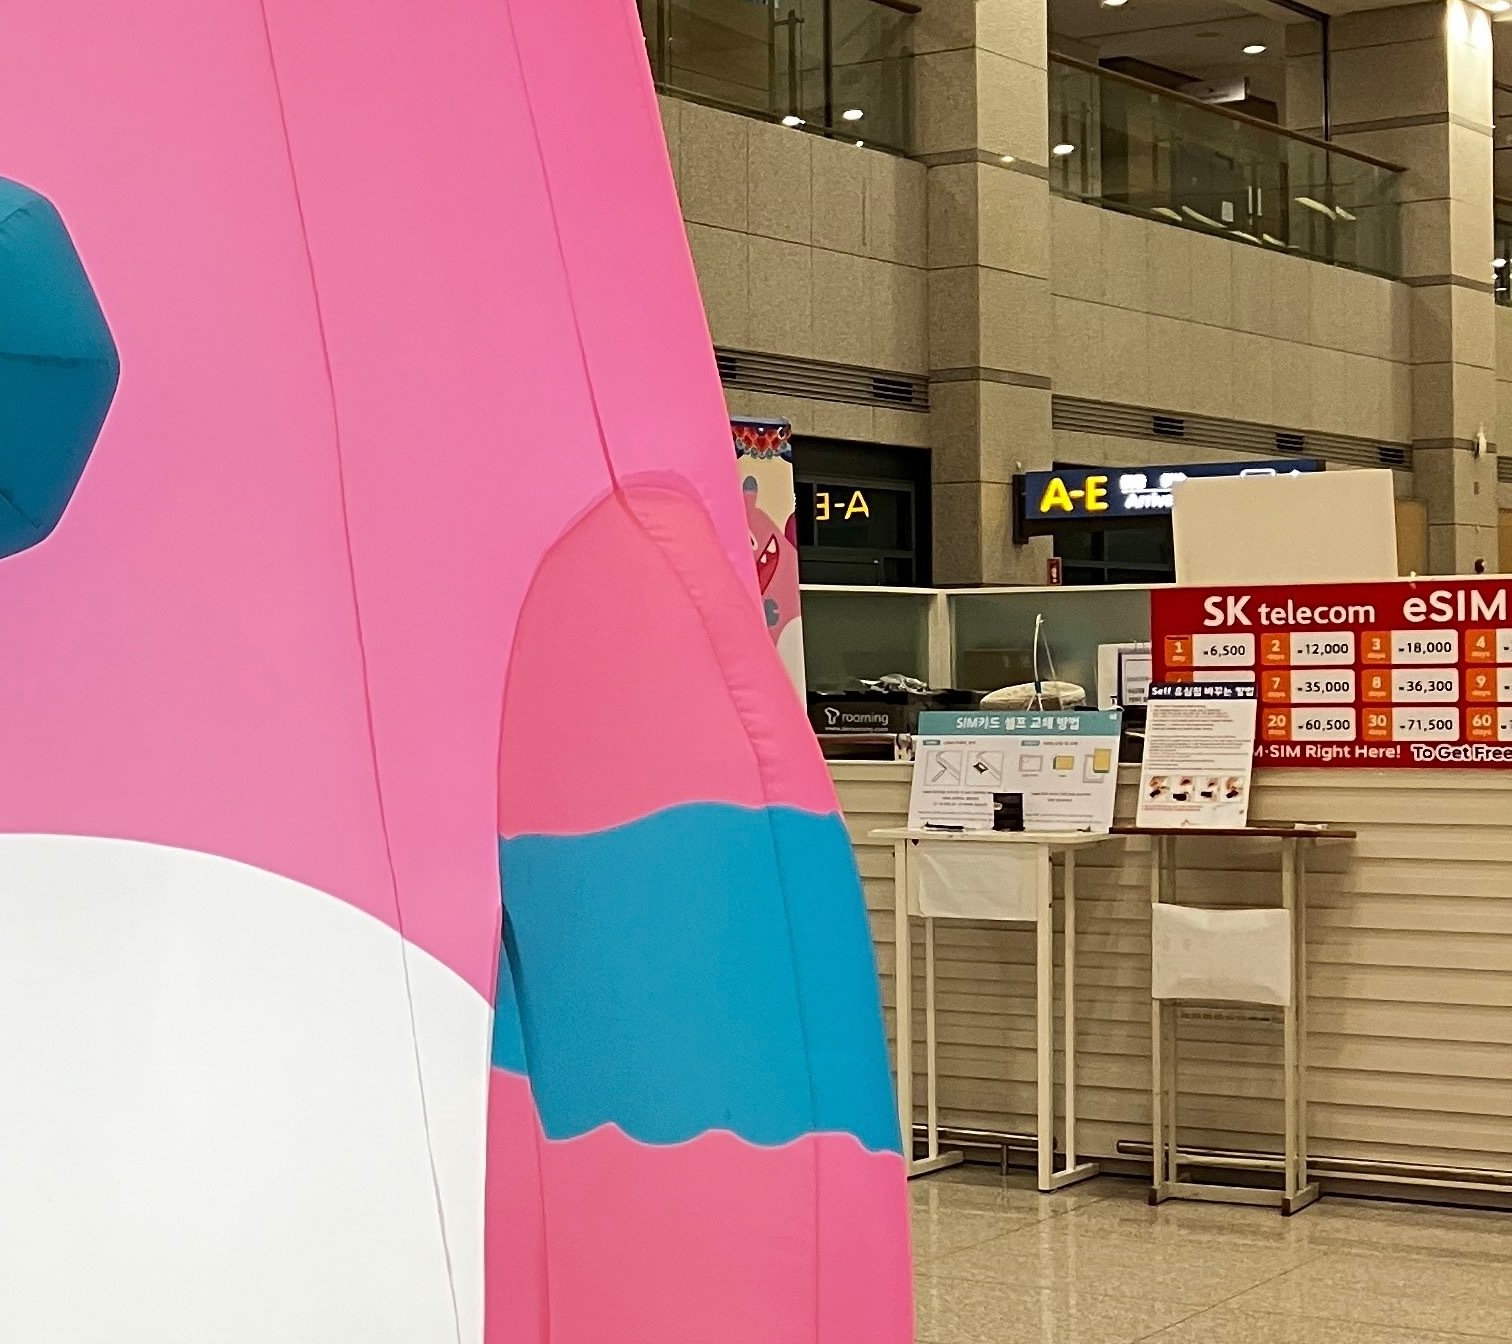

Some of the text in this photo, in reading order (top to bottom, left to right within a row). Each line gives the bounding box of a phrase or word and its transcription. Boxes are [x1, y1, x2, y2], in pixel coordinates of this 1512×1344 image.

[1040, 475, 1109, 513] A-E
[1203, 589, 1507, 627] SK telecom eSIM
[1151, 686, 1172, 697] Self
[841, 713, 889, 725] roaming
[956, 715, 1001, 730] SIM카드
[1267, 714, 1287, 728] 20
[1367, 714, 1387, 727] 30
[1472, 714, 1492, 727] 60
[1305, 744, 1352, 761] Right
[1355, 745, 1401, 758] Here!
[1412, 745, 1434, 761] To
[1437, 745, 1471, 760] Get
